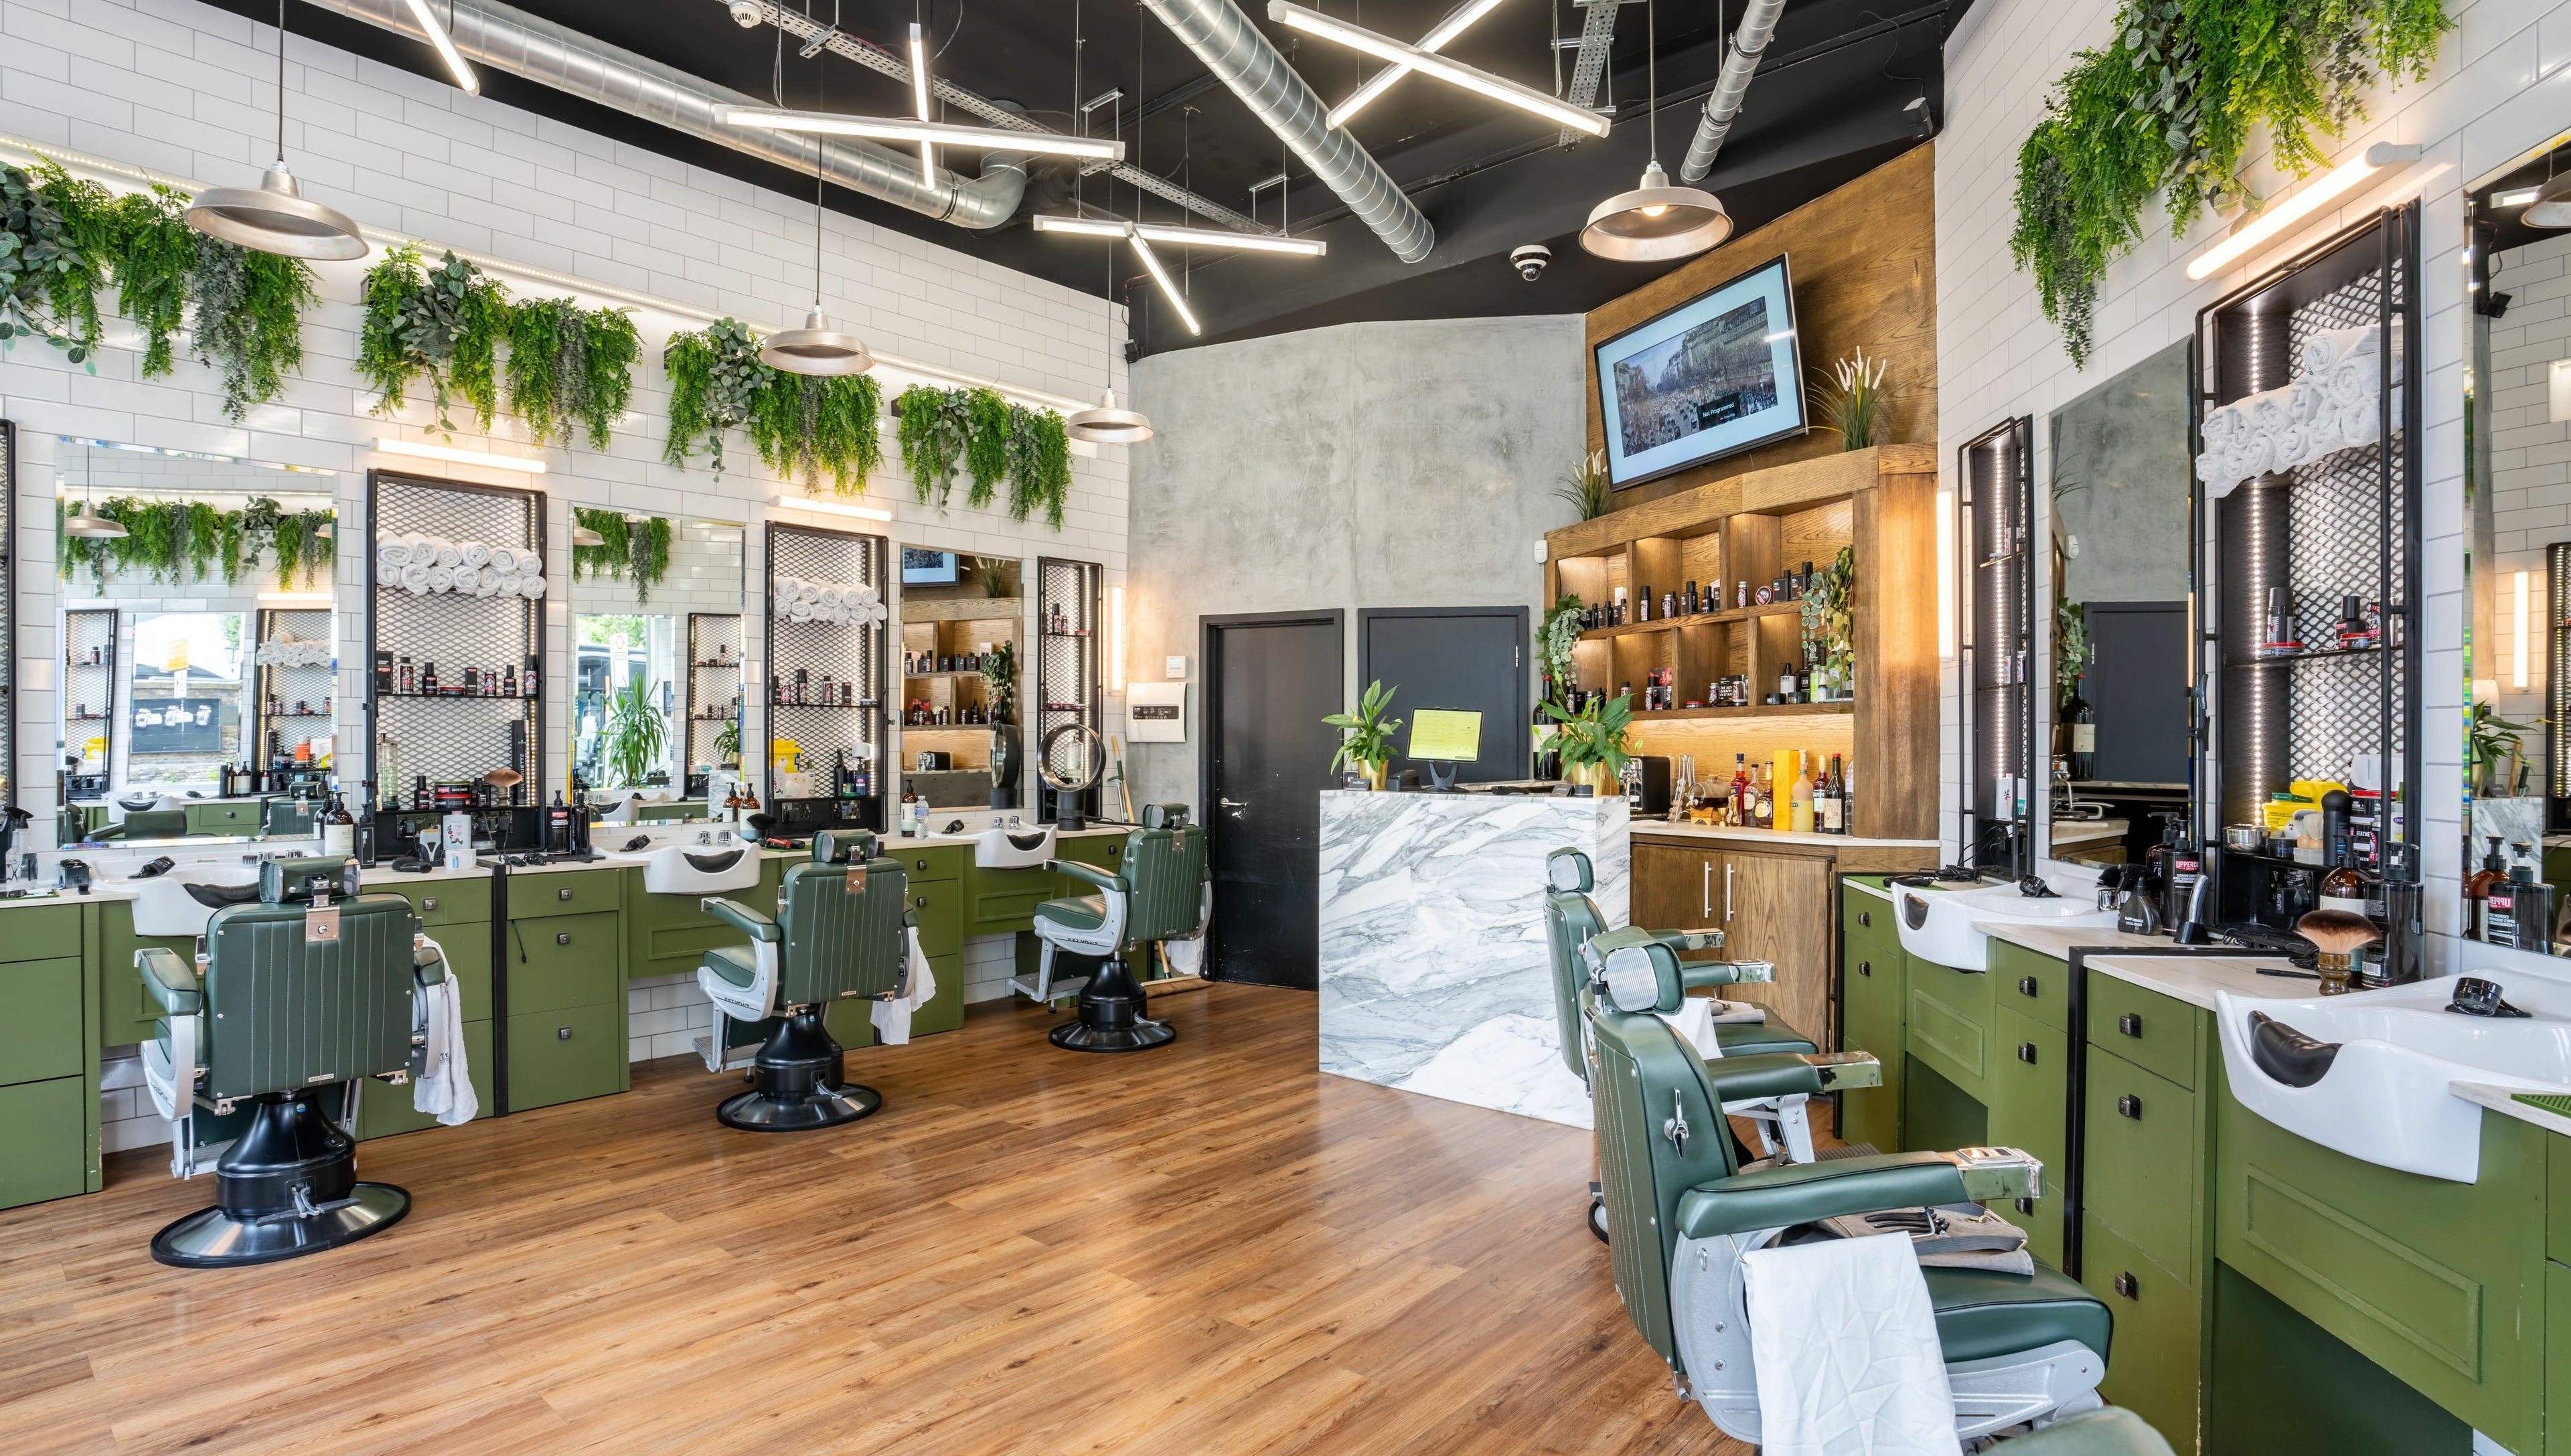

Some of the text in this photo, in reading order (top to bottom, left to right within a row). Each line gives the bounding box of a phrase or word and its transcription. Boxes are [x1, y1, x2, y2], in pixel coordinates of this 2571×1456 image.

[1711, 402, 1734, 414] Programmed
[1067, 938, 1099, 946] BELMONT
[724, 997, 750, 1008] BELMONT
